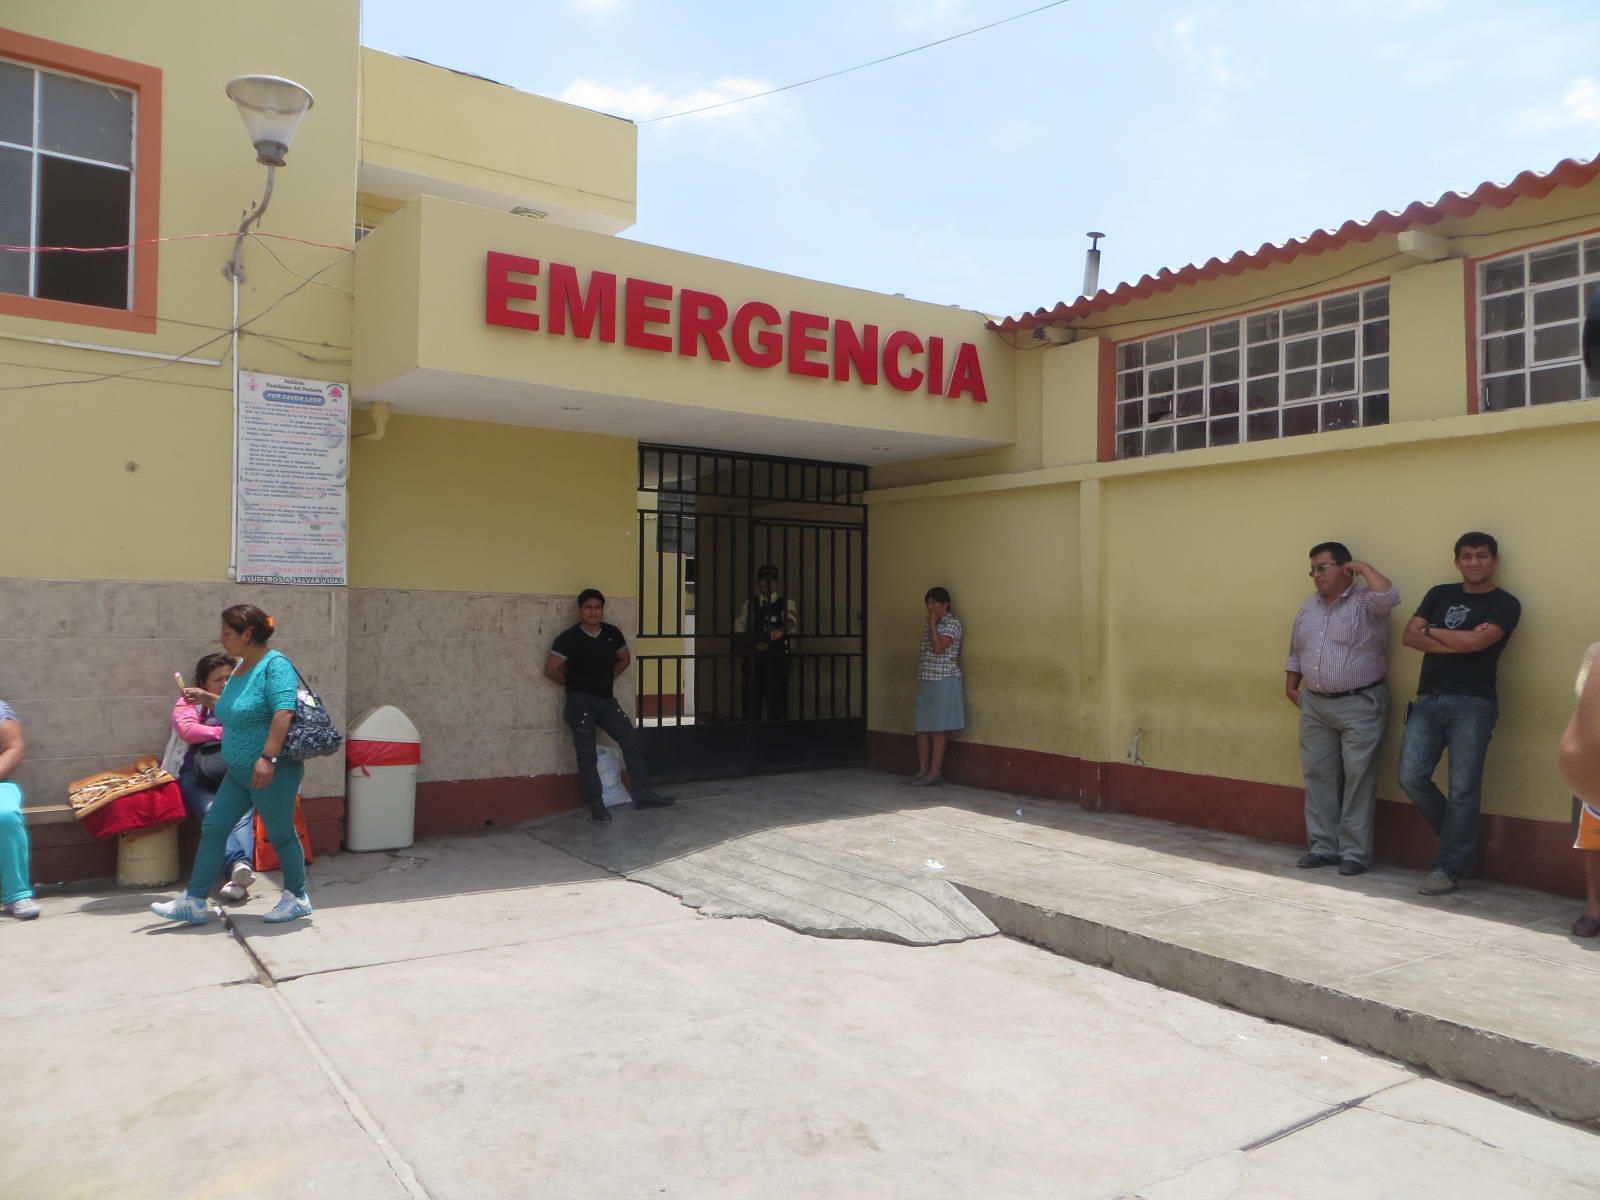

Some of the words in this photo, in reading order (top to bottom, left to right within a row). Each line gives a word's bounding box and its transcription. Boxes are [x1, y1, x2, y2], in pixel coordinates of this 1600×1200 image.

[485, 250, 988, 403] EMERGENCIA
[267, 392, 281, 400] POR
[282, 393, 303, 402] FAVOR
